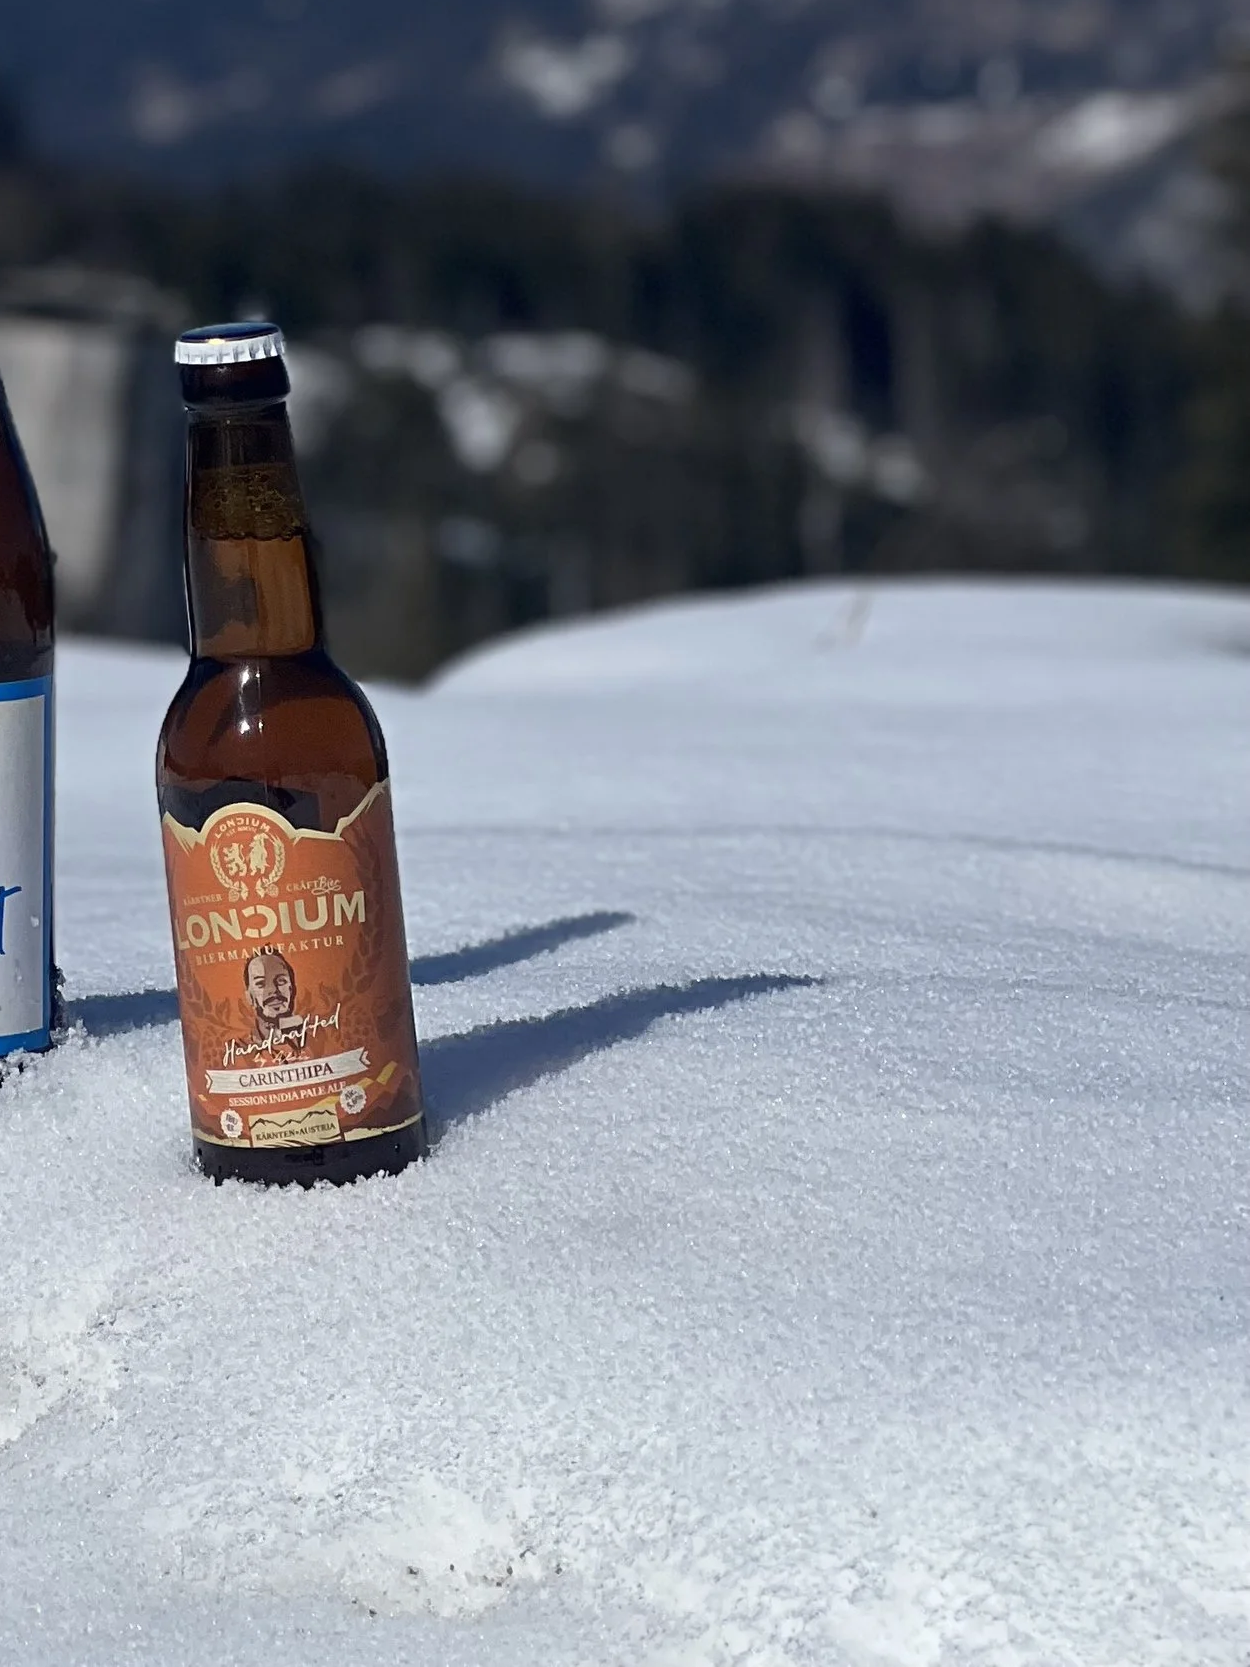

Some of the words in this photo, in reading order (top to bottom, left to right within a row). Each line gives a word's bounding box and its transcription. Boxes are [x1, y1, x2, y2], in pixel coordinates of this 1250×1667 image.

[196, 935, 345, 966] BIERMANUFAKTUR
[223, 1002, 341, 1068] Handcrafted
[238, 1062, 335, 1088] CARINTHIPA
[228, 1095, 268, 1107] SESSION
[268, 1091, 300, 1105] INDIA
[300, 1085, 327, 1099] PALE
